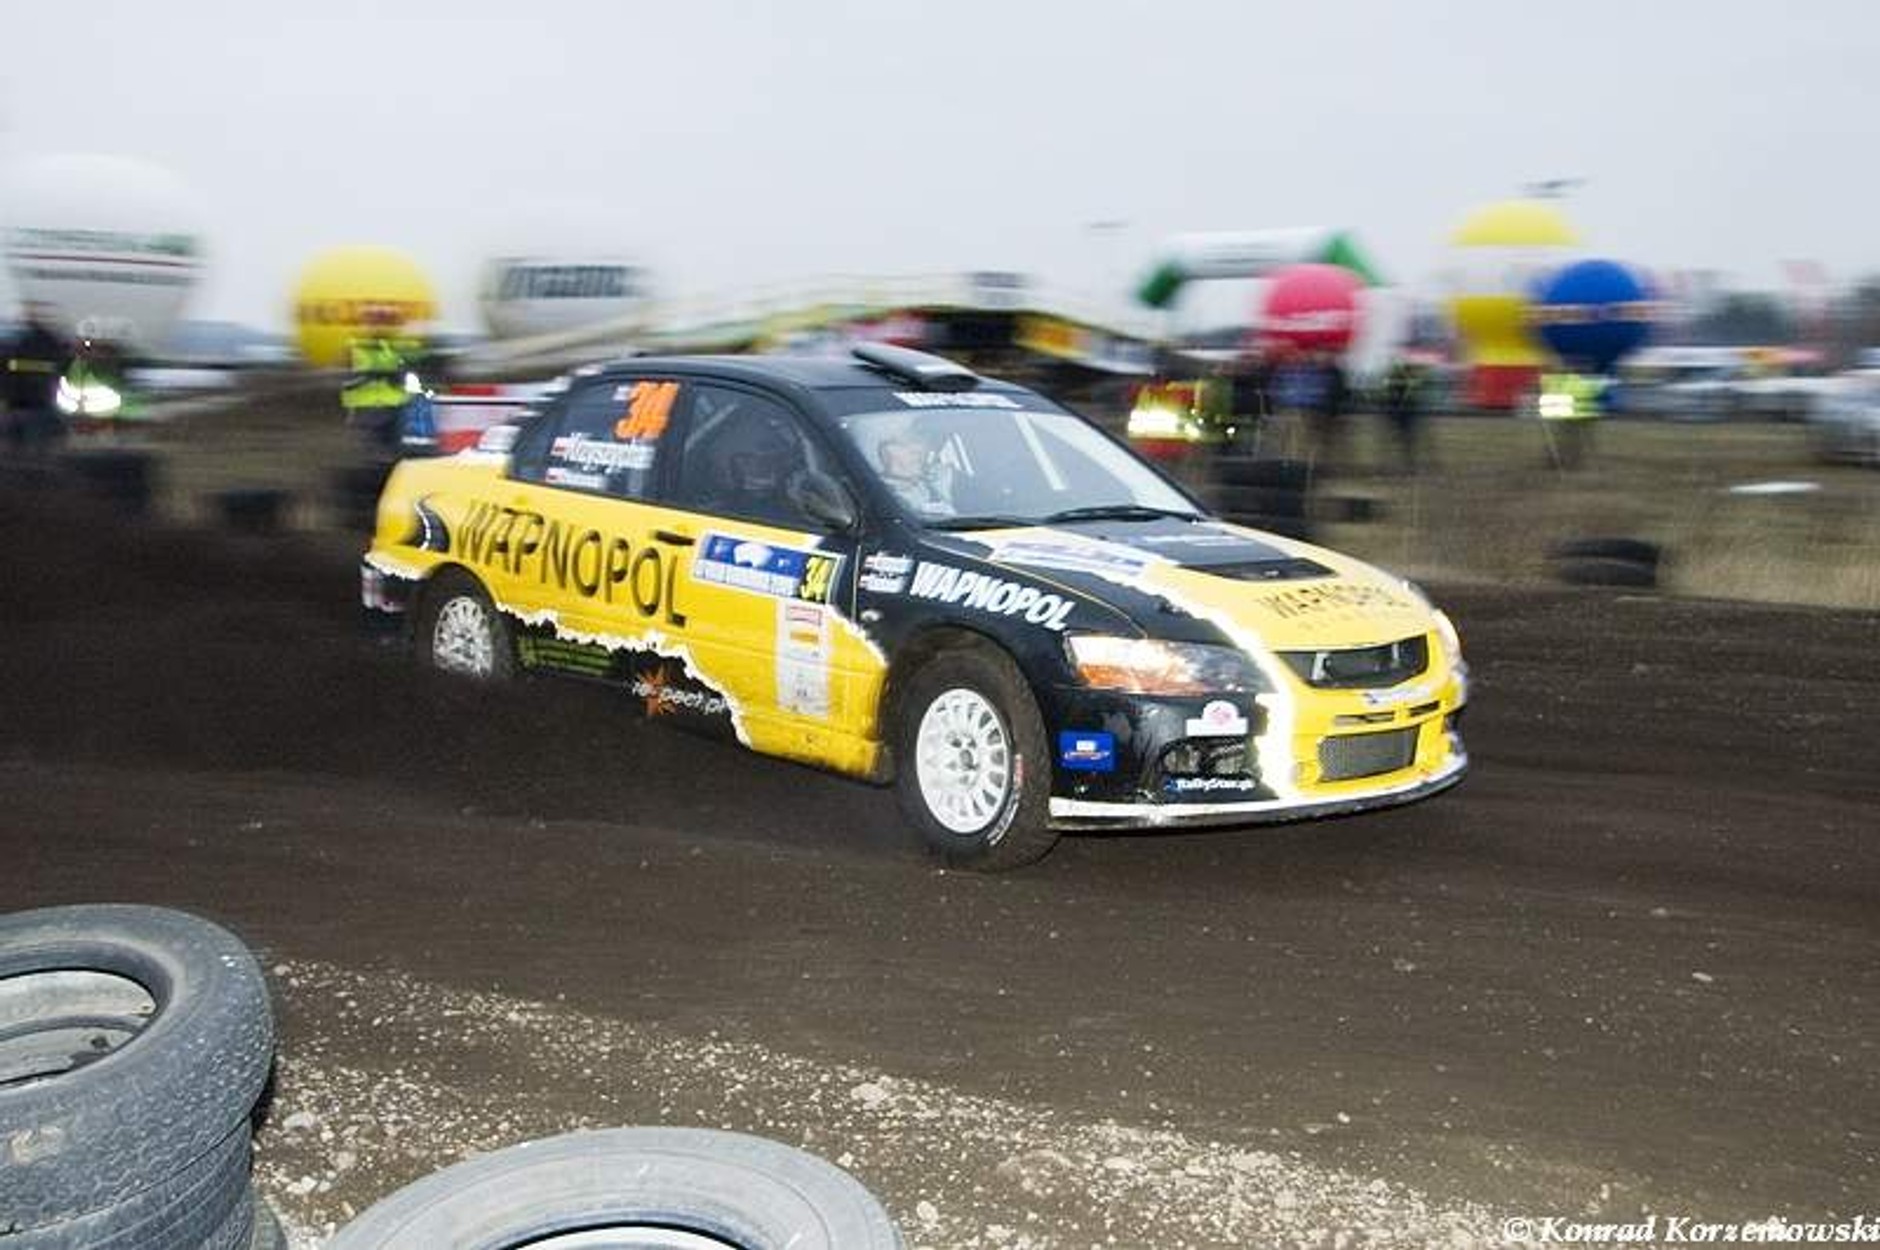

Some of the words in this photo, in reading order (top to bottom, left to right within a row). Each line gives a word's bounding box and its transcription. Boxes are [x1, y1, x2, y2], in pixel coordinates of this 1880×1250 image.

[614, 380, 680, 439] 34
[456, 500, 686, 628] WAPNOPOL
[800, 555, 831, 601] 34
[909, 561, 1076, 632] WAPNOPOL
